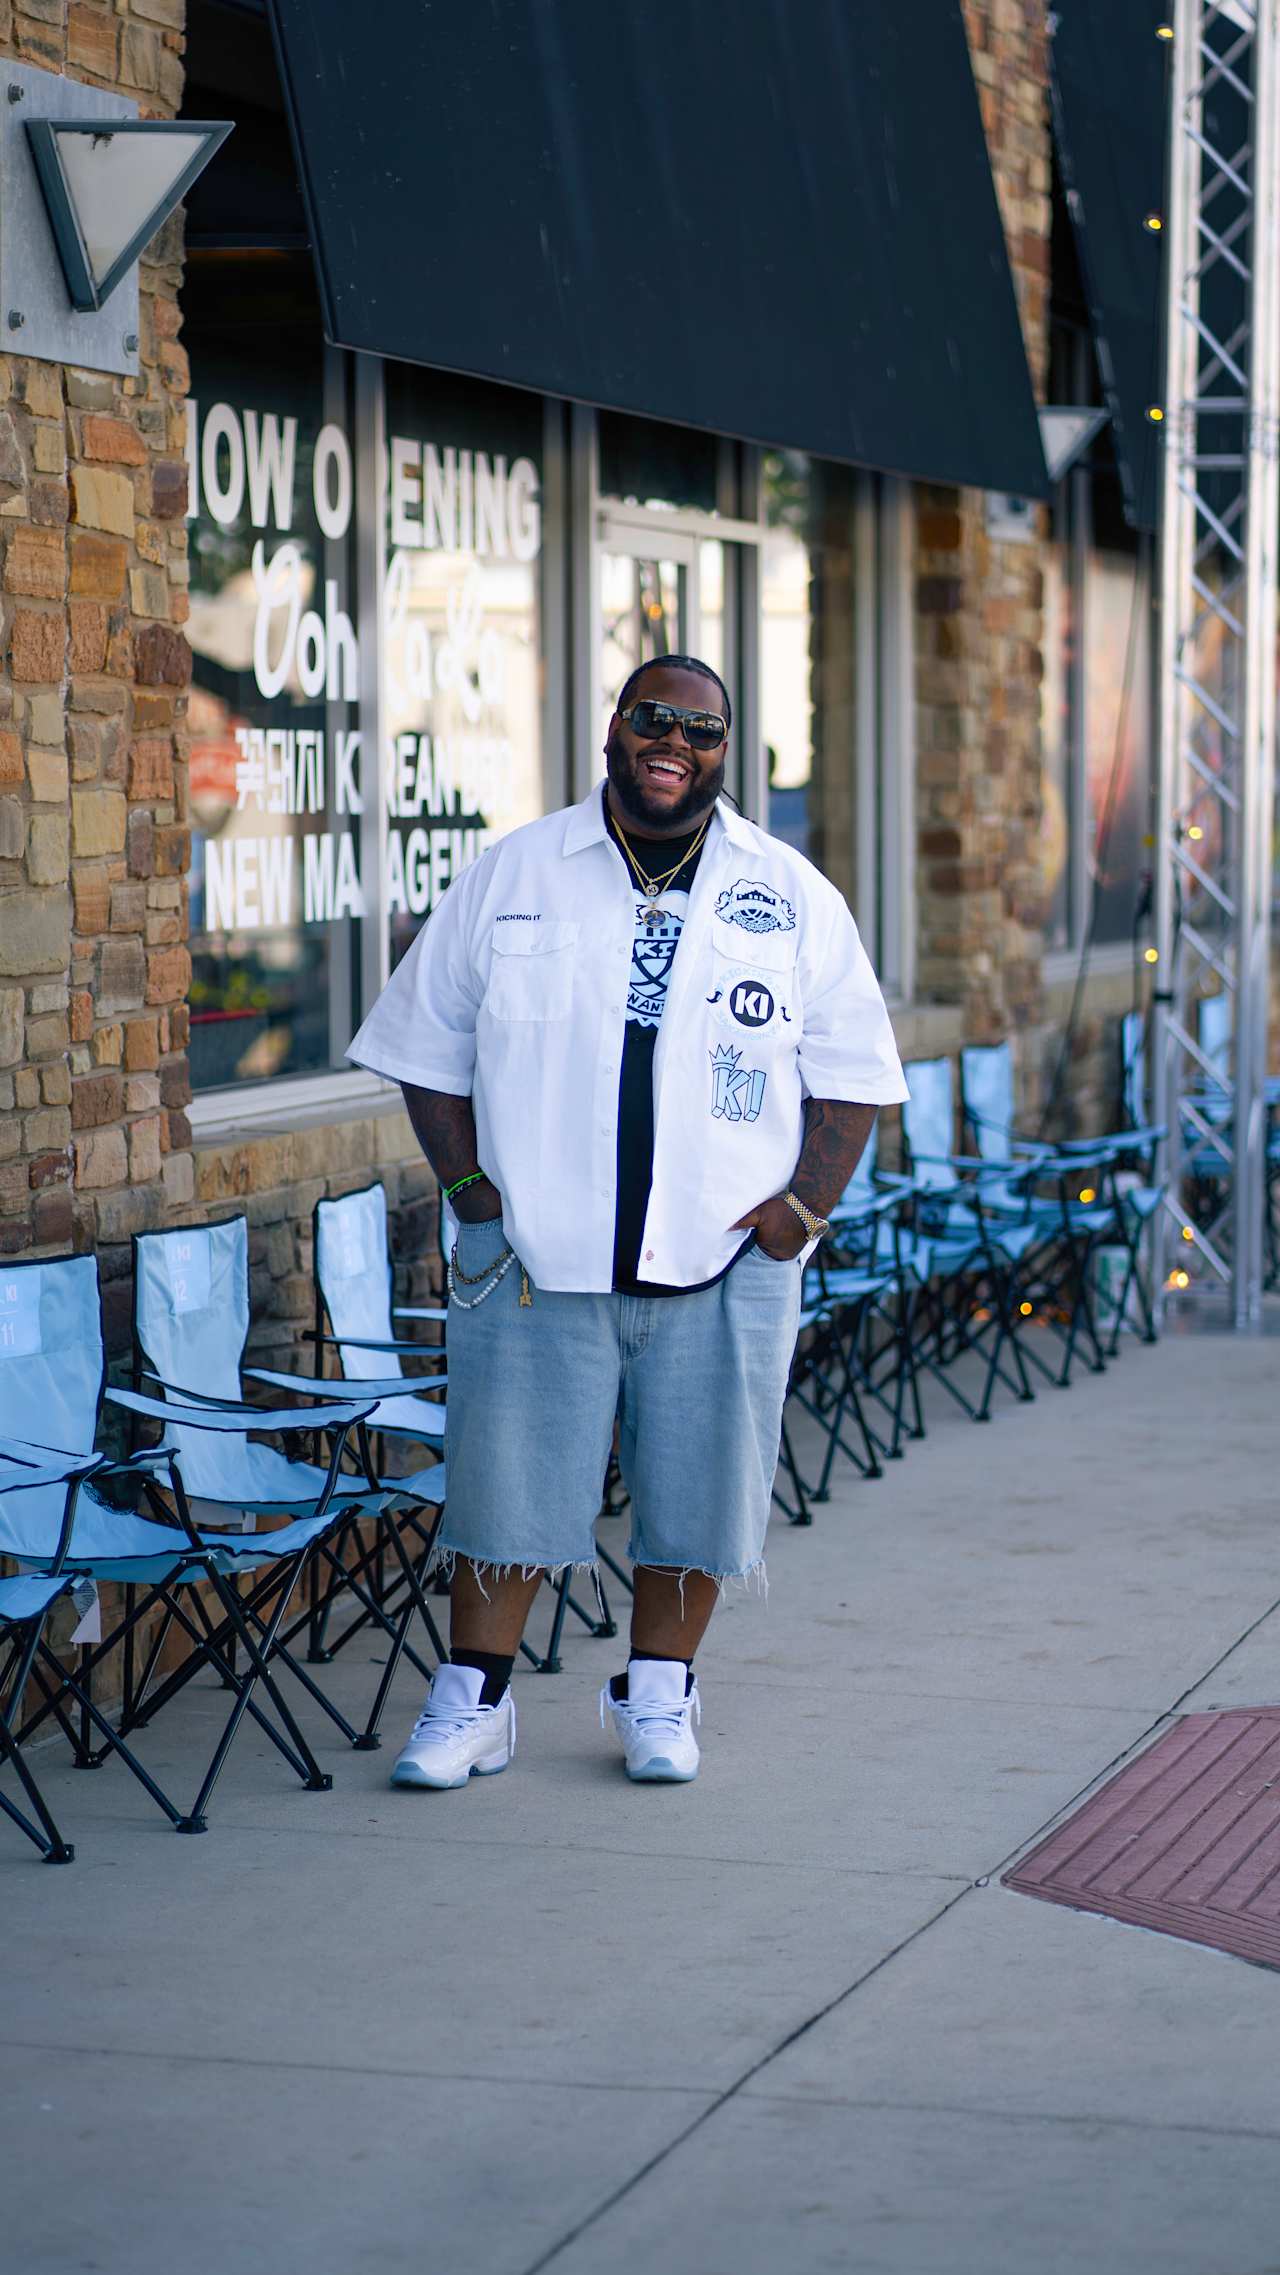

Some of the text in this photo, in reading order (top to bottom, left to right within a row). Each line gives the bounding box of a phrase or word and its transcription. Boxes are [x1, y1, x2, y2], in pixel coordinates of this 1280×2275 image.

[313, 423, 540, 561] OENING
[252, 539, 360, 699] Ooh
[206, 834, 293, 932] NEW
[496, 913, 542, 922] KICKING IT
[635, 941, 674, 958] KI
[734, 987, 770, 1020] KI
[711, 1063, 767, 1123] KI
